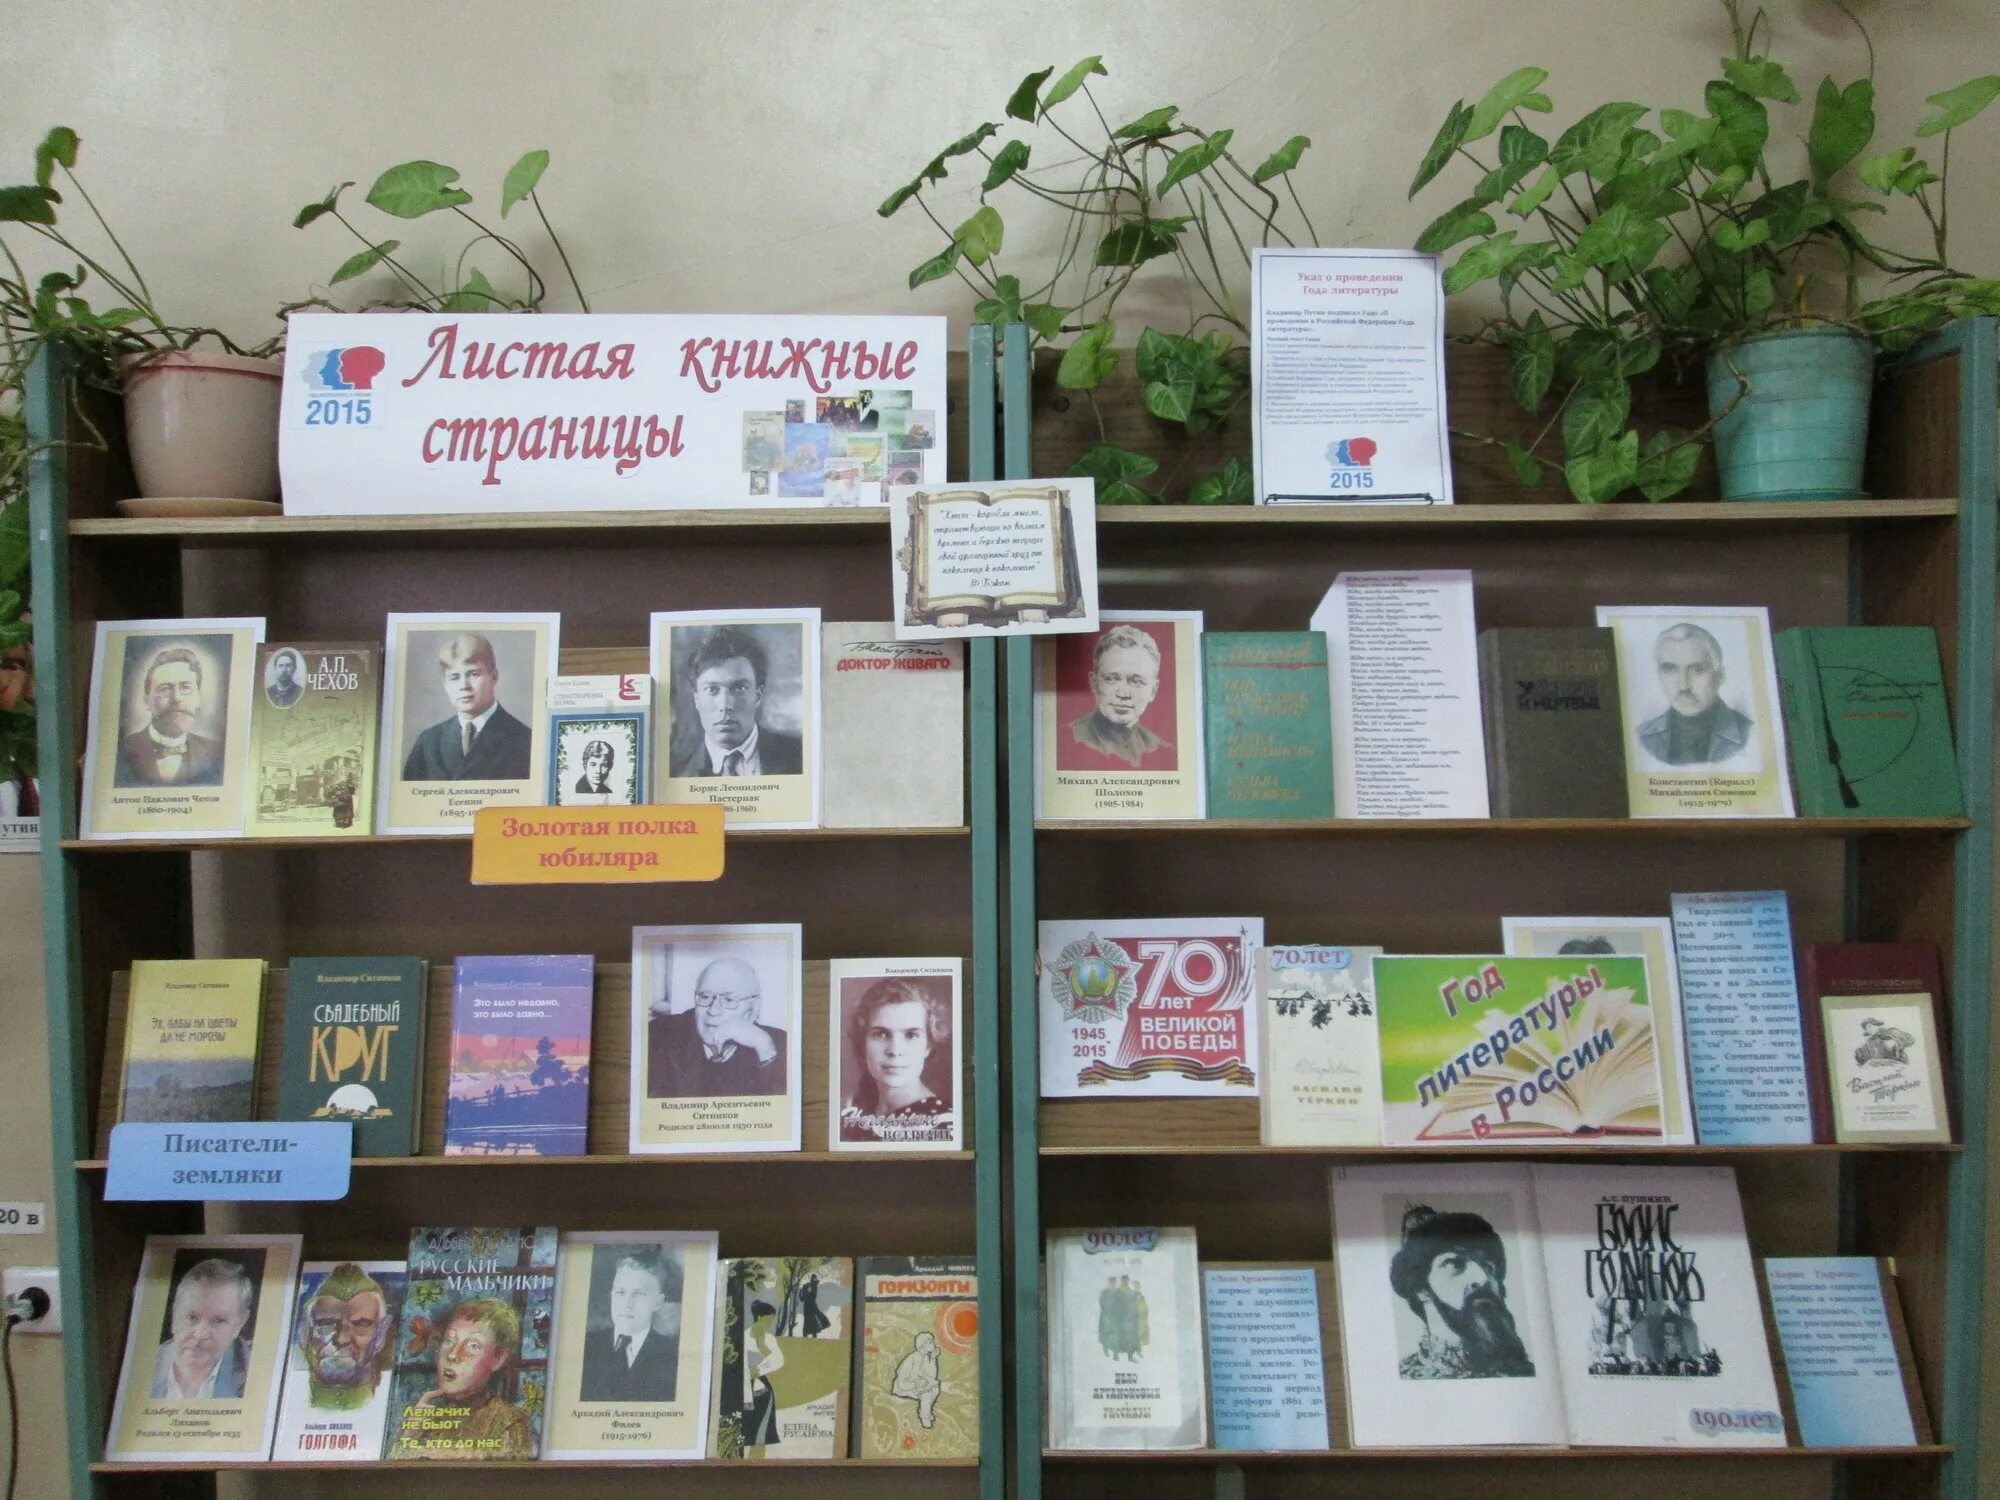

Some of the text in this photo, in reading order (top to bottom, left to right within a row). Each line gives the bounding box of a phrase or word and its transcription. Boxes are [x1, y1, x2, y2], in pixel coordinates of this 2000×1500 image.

[1297, 272, 1404, 283] Указ о проведении
[1303, 285, 1399, 296] Года литературы
[402, 323, 918, 393] Листая книжные
[305, 399, 372, 425] 2015
[422, 413, 685, 485] страницы
[1330, 472, 1374, 489] 2015
[319, 656, 349, 673] А.П.
[837, 657, 951, 672] ДОКТОР ЖИВАГО
[307, 672, 359, 690] ЧЕХОВ
[689, 783, 780, 794] Борис Леонидович
[1057, 777, 1181, 787] Михаил Александрович
[411, 787, 520, 797] Сергей Александрович
[709, 795, 760, 804] Пастернак
[1095, 788, 1143, 797] Шолохов
[448, 798, 482, 806] Есенин
[501, 817, 698, 838] Золотая полка
[538, 846, 660, 871] юбиляра
[1138, 940, 1229, 1010] 70
[1440, 964, 1506, 1018] Год
[474, 999, 491, 1007] Это
[1159, 996, 1194, 1010] лет
[314, 1000, 400, 1022] СВАДЕБНЫЙ
[1140, 1014, 1236, 1033] ВЕЛИКОЙ
[1071, 1027, 1106, 1040] 1945
[1416, 964, 1604, 1108] литературы
[1072, 1044, 1106, 1057] 2015
[1141, 1034, 1237, 1052] ПОБЕДЫ
[309, 1025, 399, 1082] КРУГ
[1471, 1028, 1616, 1139] в России
[661, 1101, 771, 1110] Владимир Арсентьевич
[692, 1112, 739, 1120] Ситников
[658, 1123, 694, 1132] Родился
[164, 1133, 298, 1153] Писатели-
[172, 1168, 282, 1185] земляки
[420, 1258, 501, 1274] РУССКИЕ
[446, 1275, 546, 1291] МАЛЬЧИКИ
[878, 1280, 970, 1294] ГОРИЗОНТЫ
[403, 1406, 471, 1417] Лежачих
[571, 1409, 685, 1419] Аркадий Александрович
[402, 1419, 461, 1430] не бьют
[298, 1434, 357, 1450] ГОЛГОФА
[400, 1437, 502, 1450] Те, кто до нас
